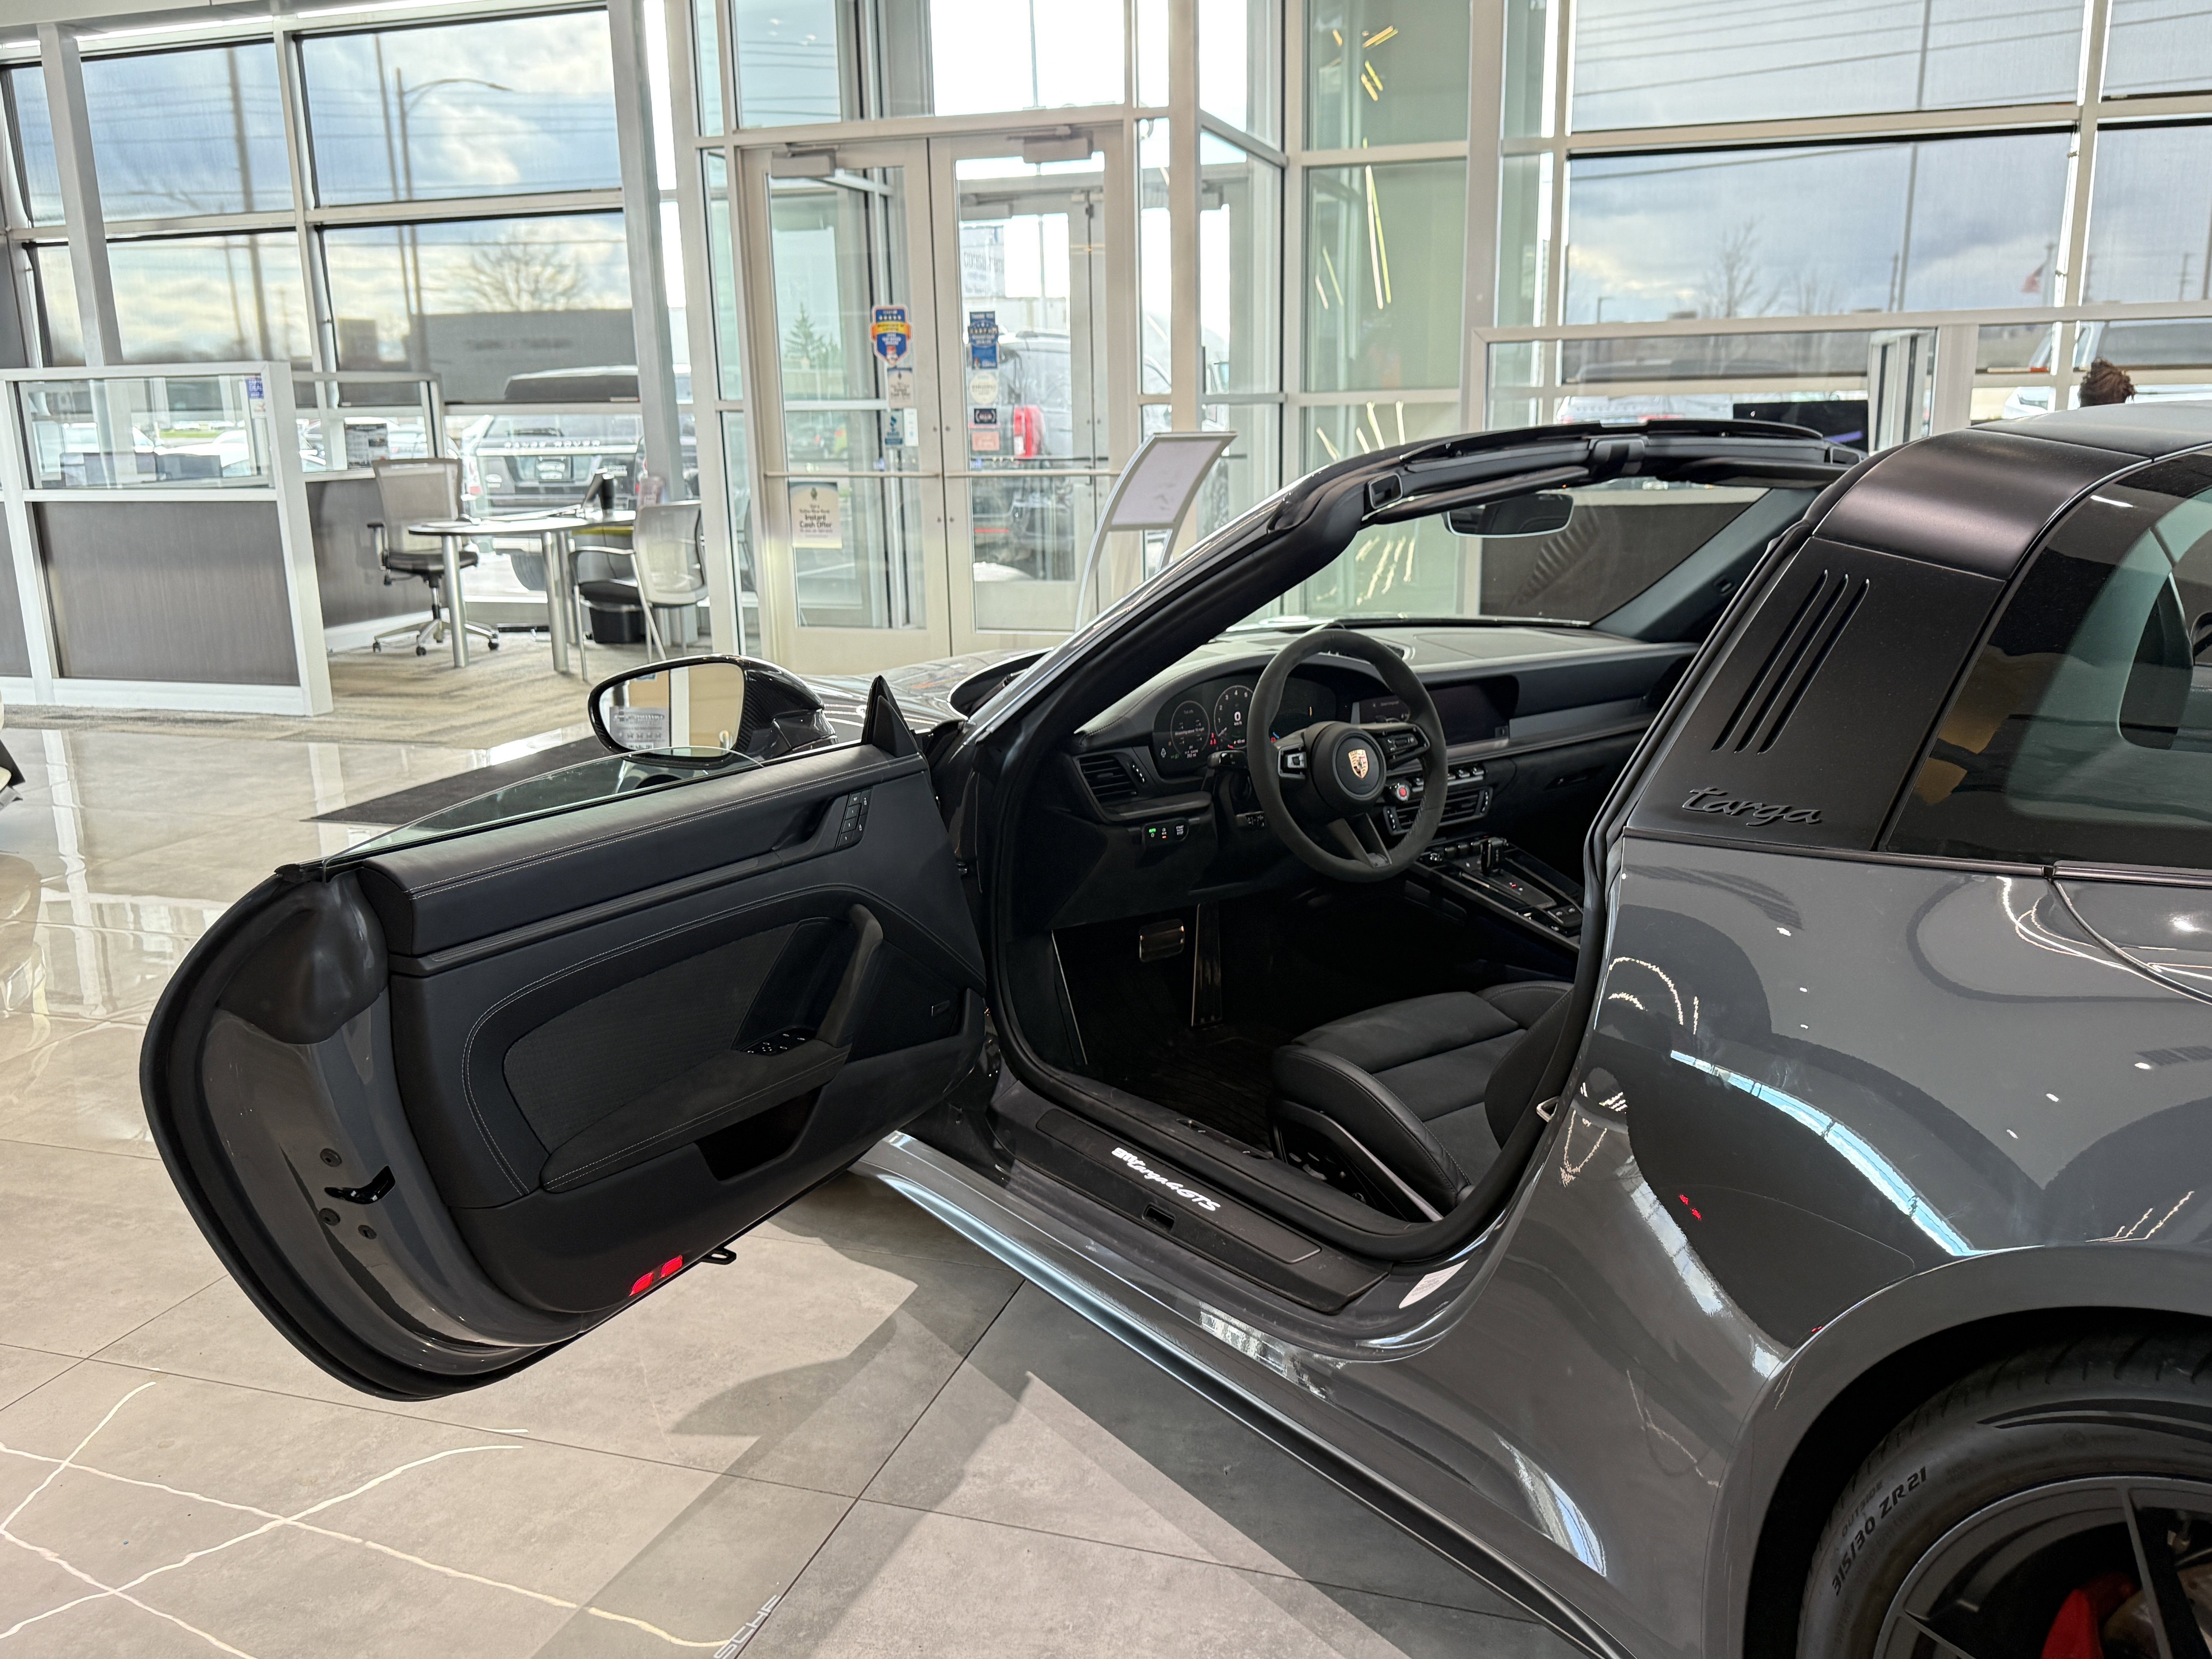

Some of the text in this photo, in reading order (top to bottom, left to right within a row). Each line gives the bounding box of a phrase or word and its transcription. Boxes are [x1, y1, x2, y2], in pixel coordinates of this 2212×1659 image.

[1682, 787, 1821, 827] targa
[1176, 1188, 1221, 1211] GTS
[1832, 1516, 1876, 1597] 315/30
